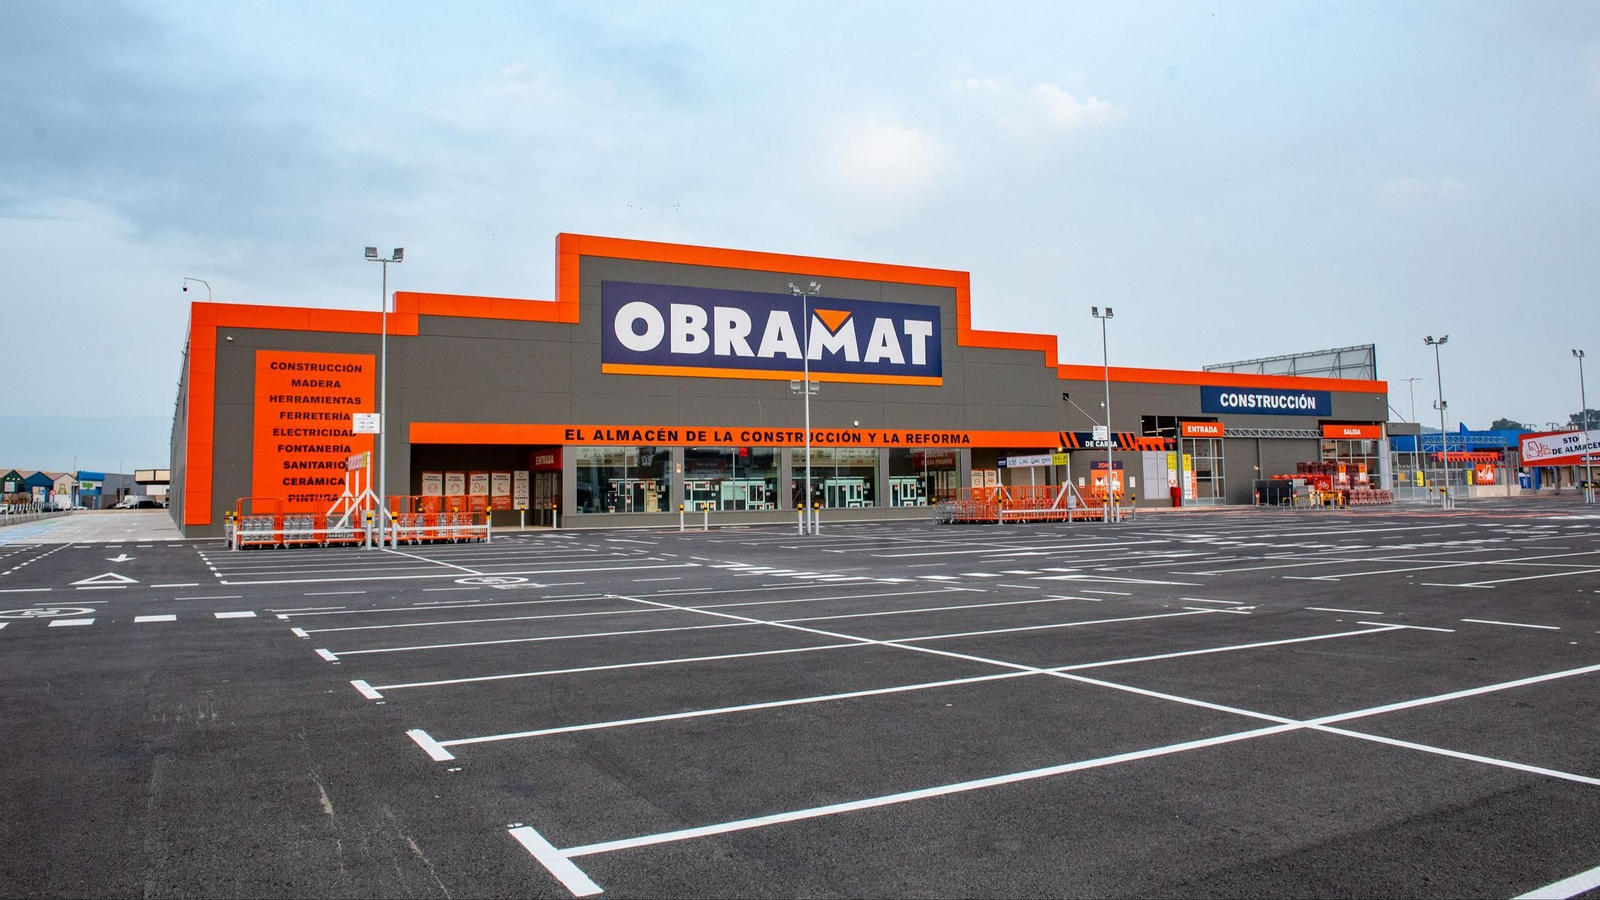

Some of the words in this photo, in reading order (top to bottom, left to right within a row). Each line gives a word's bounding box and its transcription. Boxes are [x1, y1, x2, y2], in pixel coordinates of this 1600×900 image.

[614, 301, 933, 365] OBRAMAT
[270, 361, 362, 373] CONSTRUCCIÓN
[291, 379, 341, 388] MADERA
[269, 395, 362, 405] HERRAMIENTAS
[1220, 393, 1316, 410] CONSTRUCCIÓN
[279, 411, 351, 421] FERRETERÍA
[272, 428, 357, 437] ELECTRICIDAD
[1187, 425, 1218, 434] ENTRADA
[1343, 428, 1361, 436] SALIDA
[564, 429, 585, 440] EL
[592, 428, 679, 442] ALMACÉN
[685, 430, 707, 442] DE
[714, 431, 733, 442] LA
[740, 430, 861, 443] CONSTRUCCIÓN
[868, 432, 877, 443] Y
[883, 433, 900, 443] LA
[905, 433, 970, 444] REFORMA
[277, 443, 352, 454] FONTANERÍA
[1085, 440, 1094, 448] DE
[1552, 447, 1563, 455] DE
[283, 460, 346, 470] SANITARIO
[535, 454, 555, 466] ENTRADA
[282, 475, 346, 486] CERÁMICA
[287, 493, 339, 503] PINTURA
